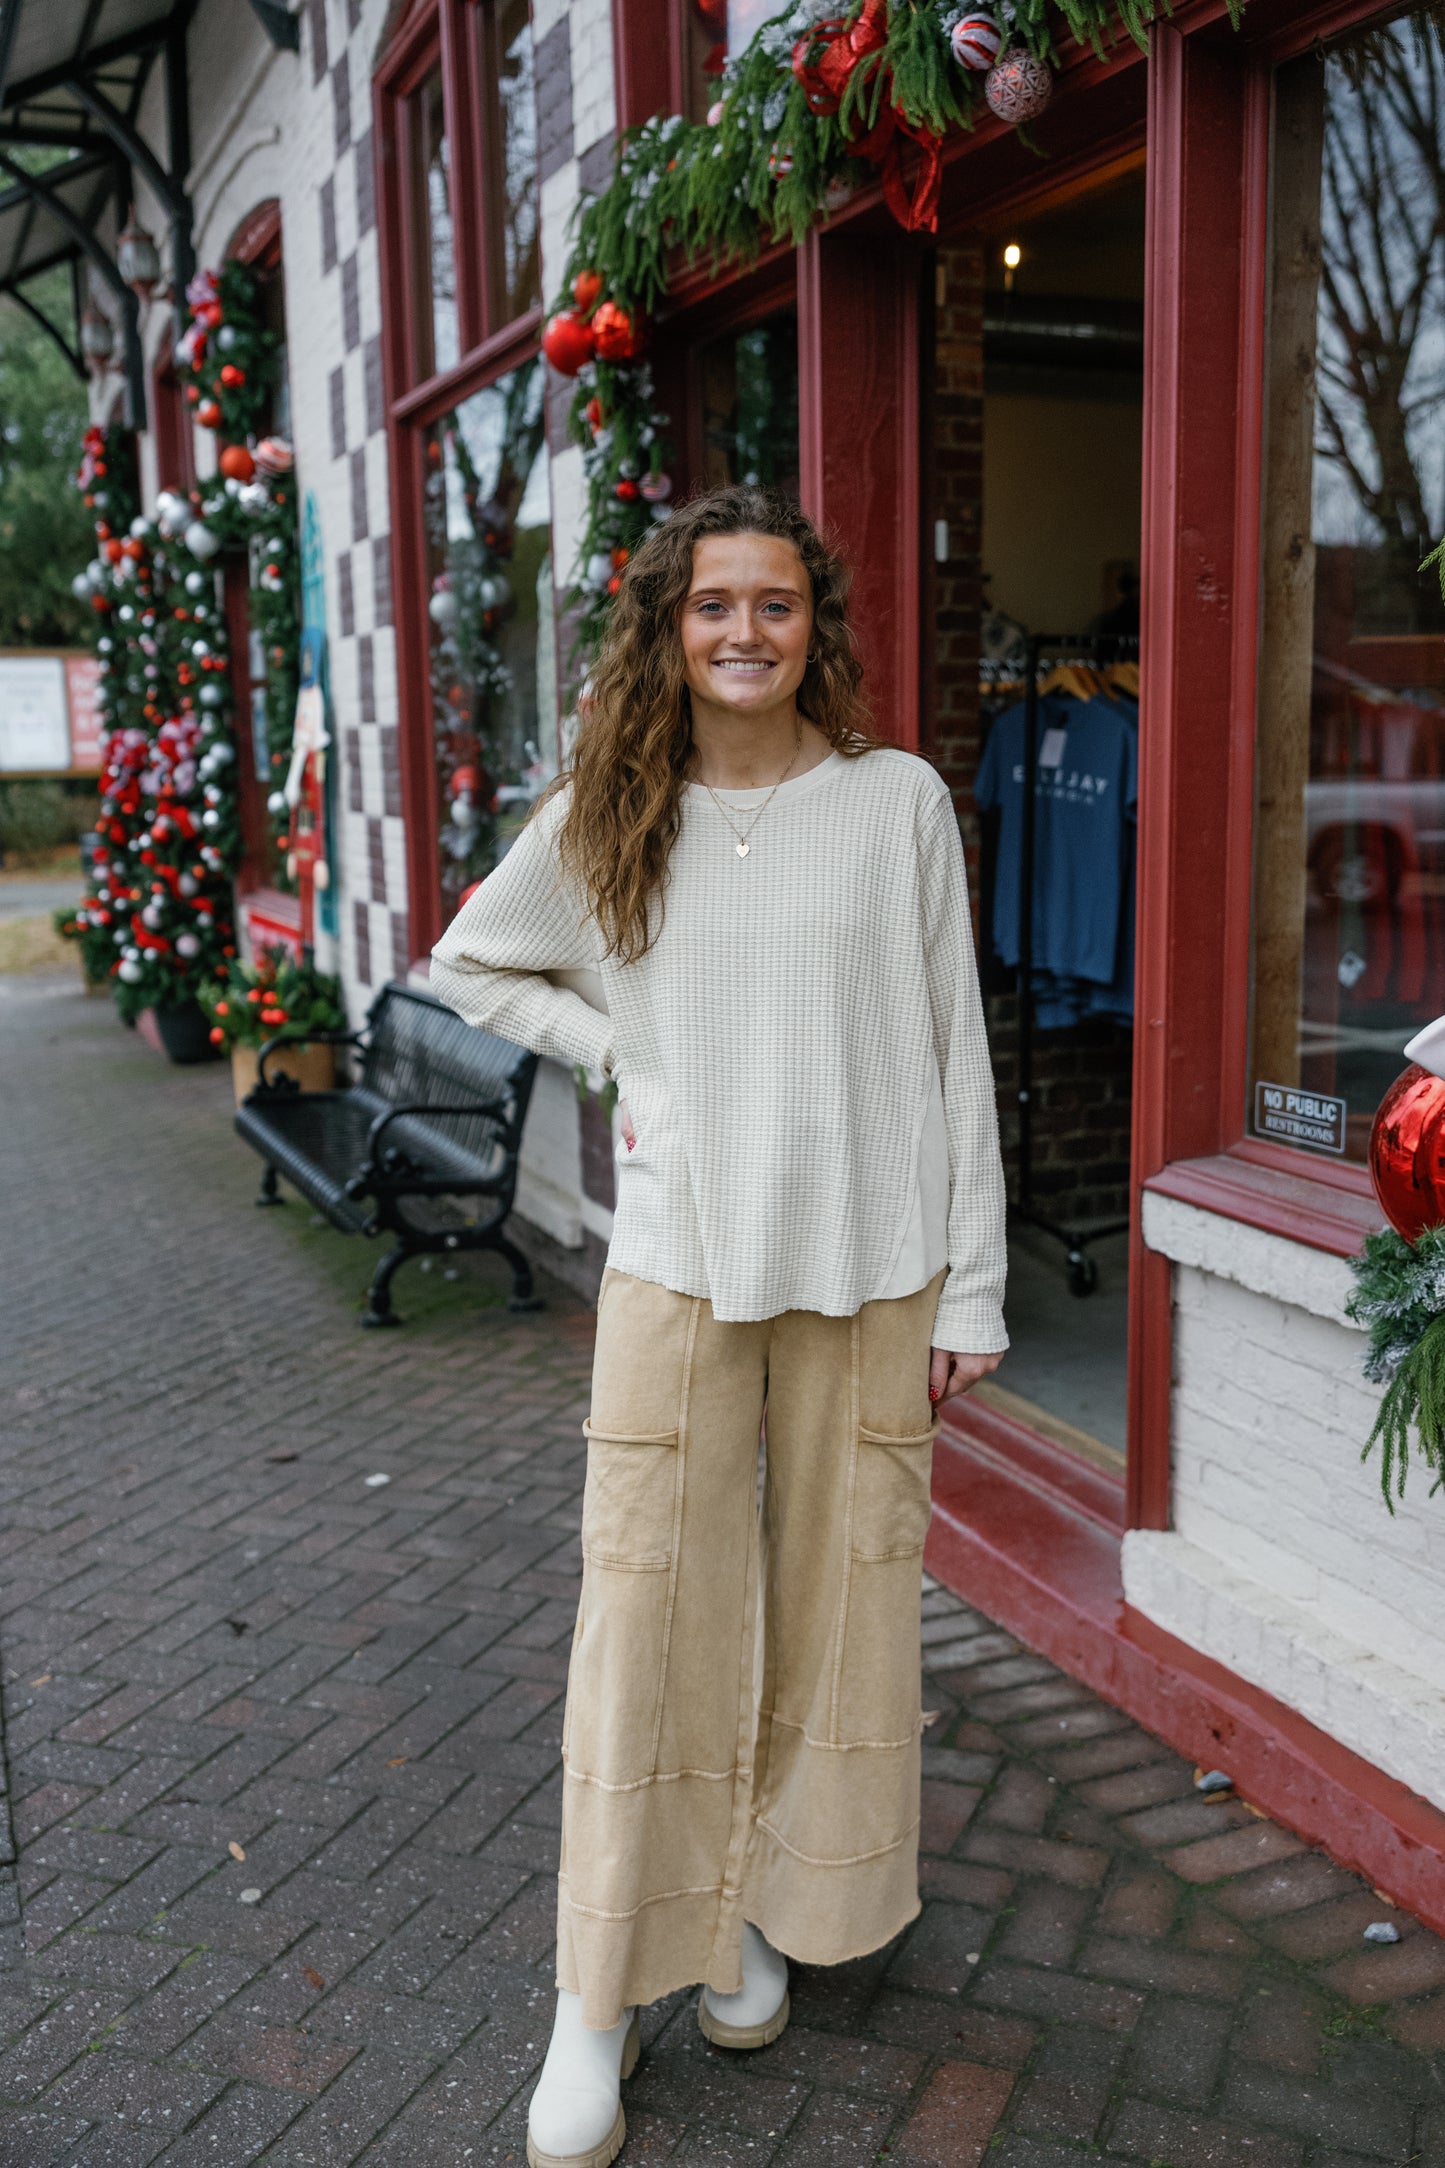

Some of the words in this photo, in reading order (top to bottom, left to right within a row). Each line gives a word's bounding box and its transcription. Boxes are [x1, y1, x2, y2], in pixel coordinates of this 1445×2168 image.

[1012, 764, 1108, 795] ELIJAY
[1264, 1089, 1282, 1109] NO
[1286, 1094, 1337, 1122] PUBLIC
[1265, 1115, 1335, 1143] RESTROOMS
